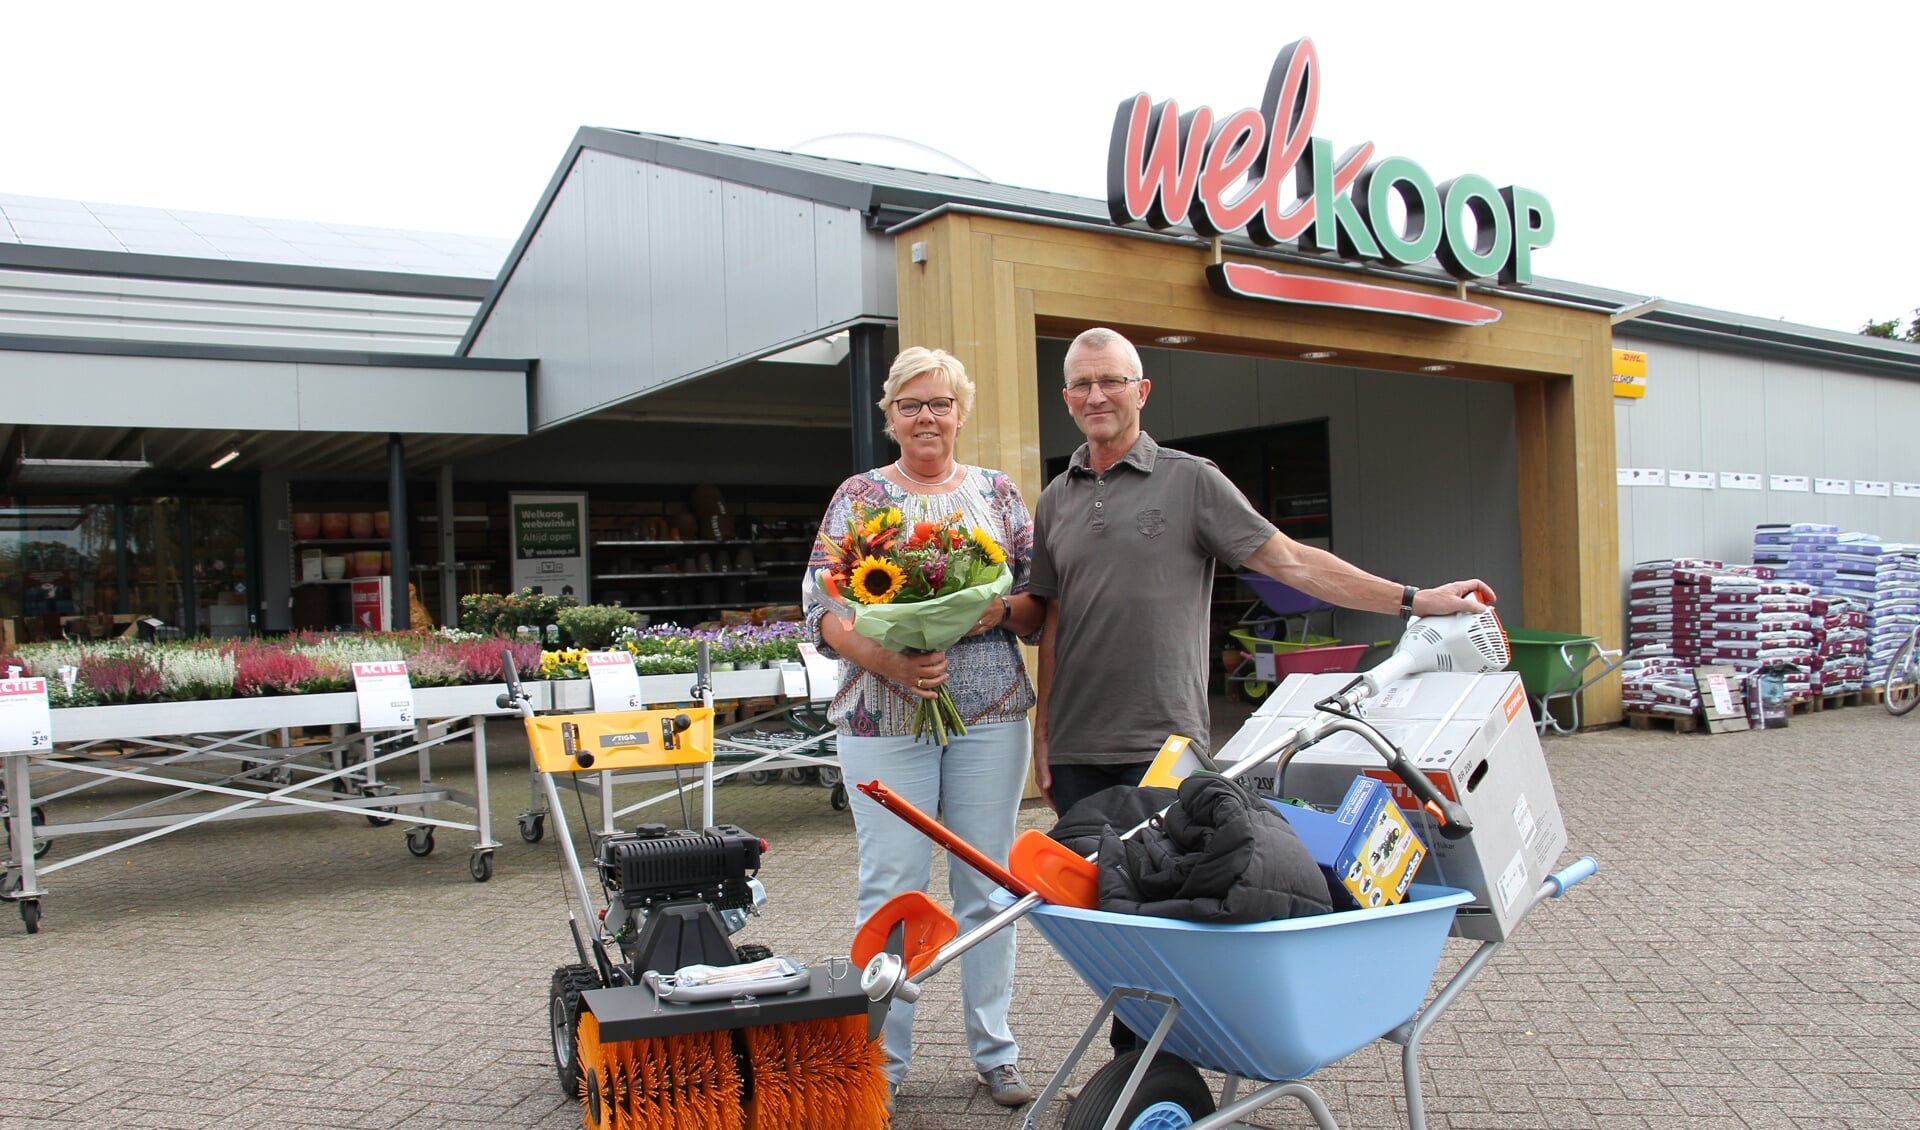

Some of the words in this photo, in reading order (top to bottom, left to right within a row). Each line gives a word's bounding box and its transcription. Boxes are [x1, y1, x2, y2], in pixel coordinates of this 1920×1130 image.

[1623, 353, 1641, 362] DHL
[521, 509, 564, 520] Welkoop
[521, 518, 575, 528] webwinkel
[523, 533, 547, 543] Altijd
[549, 533, 572, 542] open
[536, 547, 576, 556] welkoop.nl
[592, 654, 626, 664] ACTIE
[361, 664, 401, 675] ACTIE
[0, 681, 38, 694] CTIE
[611, 734, 637, 742] STIGA
[1396, 851, 1422, 895] bruder
